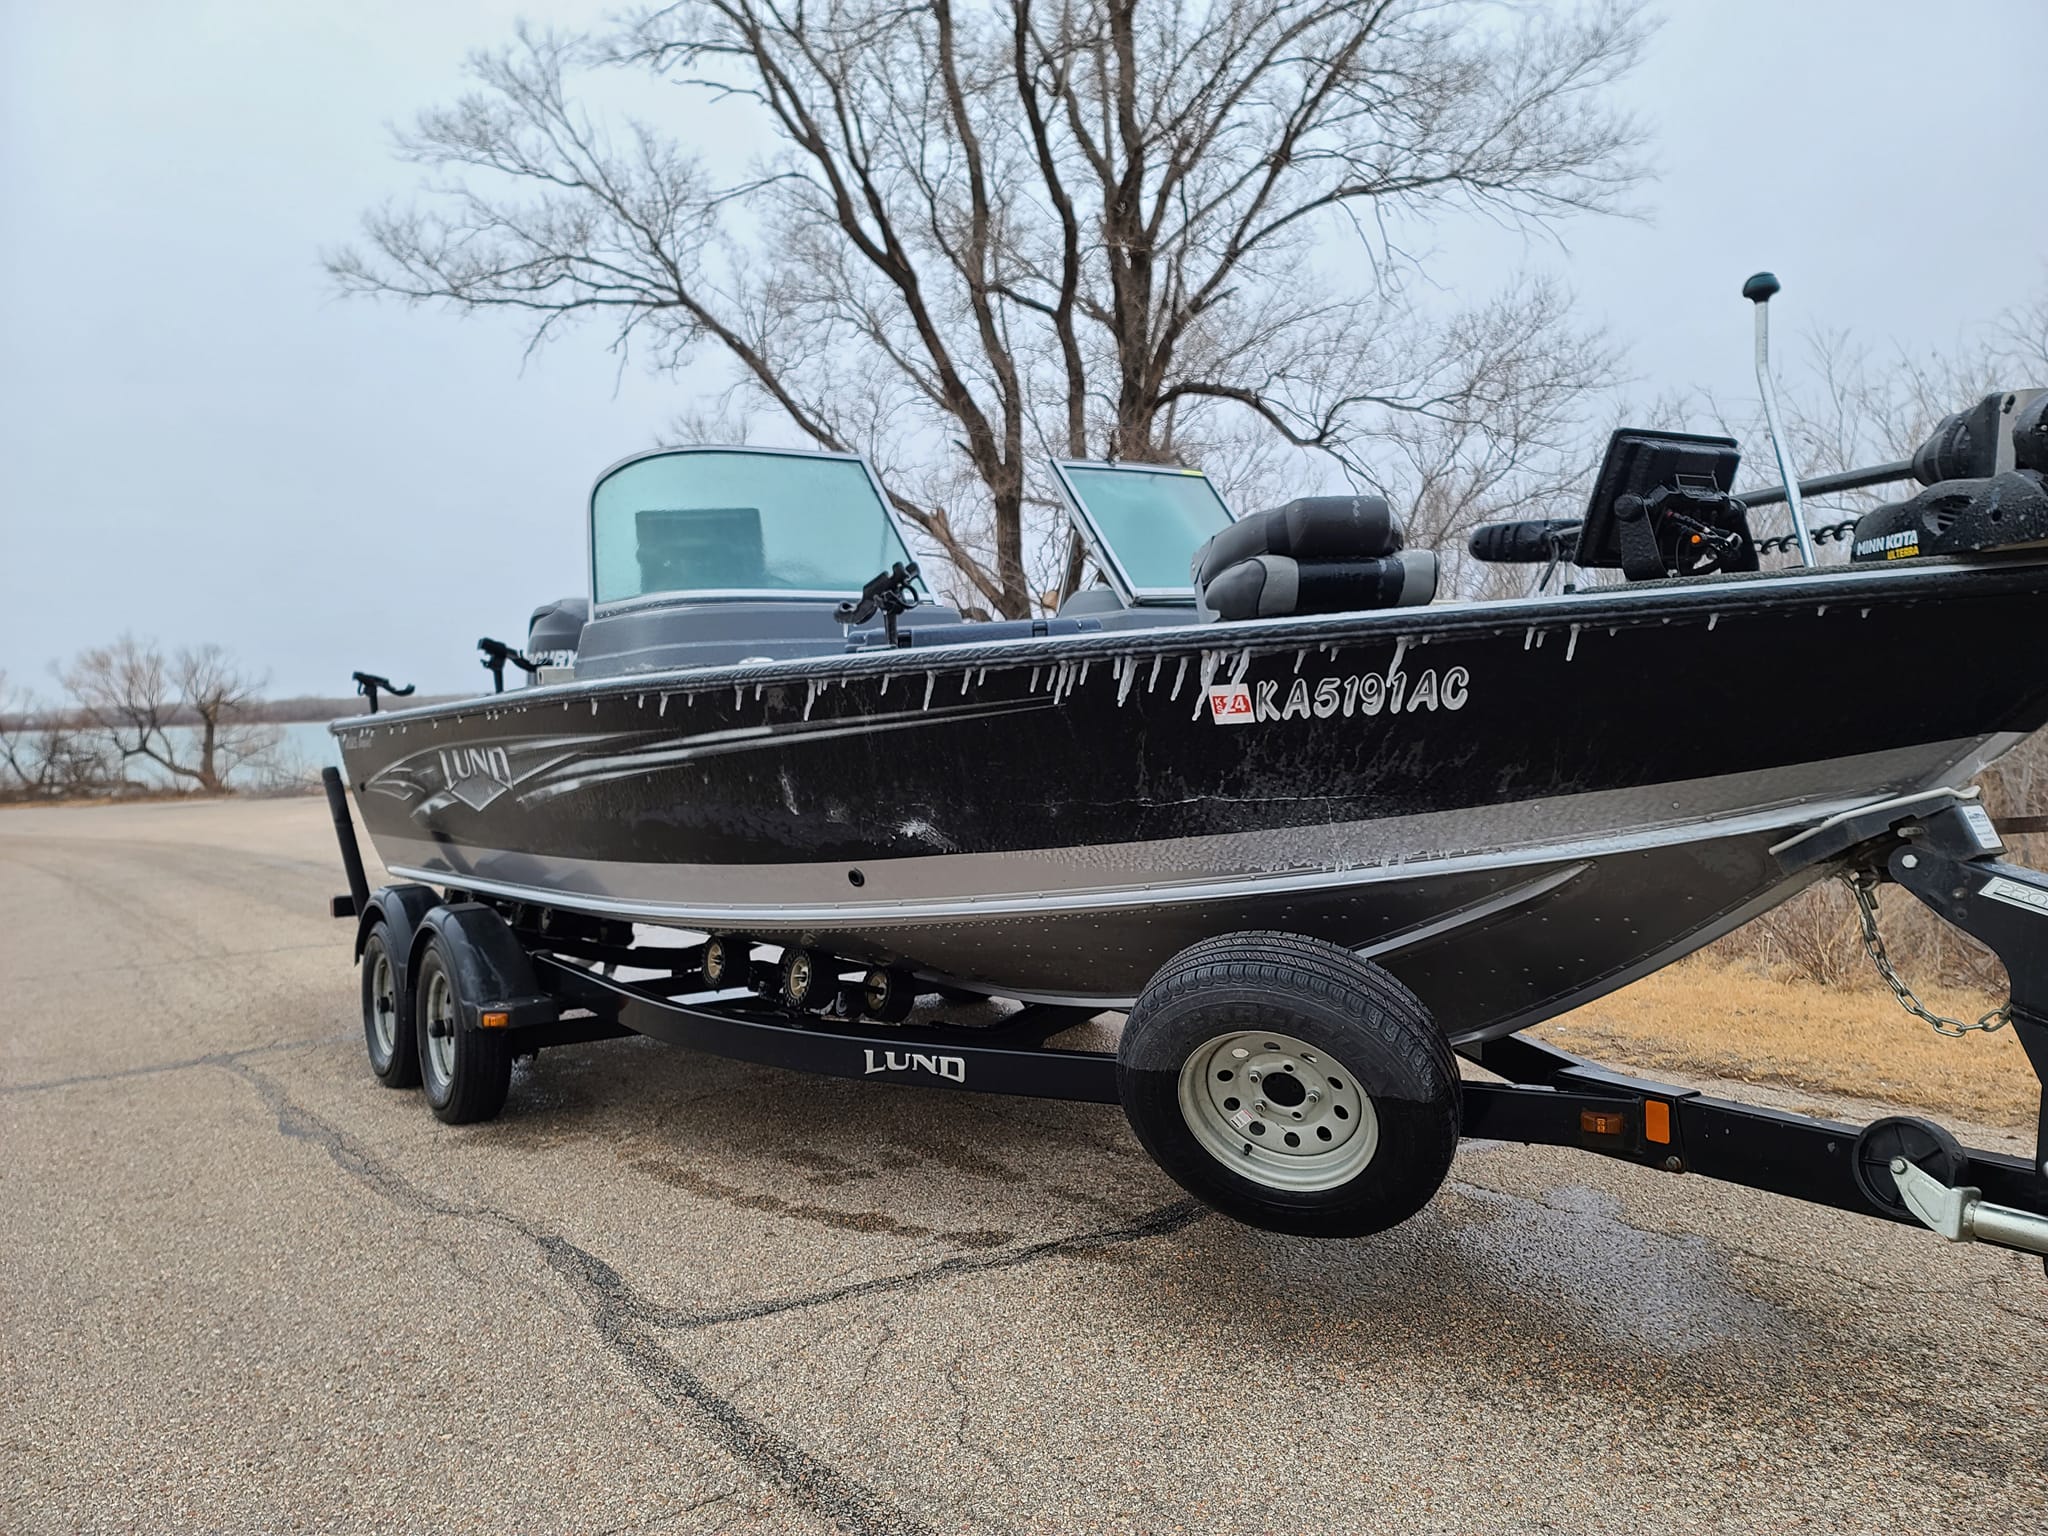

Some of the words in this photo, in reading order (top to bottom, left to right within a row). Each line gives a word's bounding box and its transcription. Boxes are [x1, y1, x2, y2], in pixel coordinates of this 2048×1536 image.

[1857, 537, 1885, 556] MINN
[1886, 530, 1919, 549] KOTA
[1256, 666, 1470, 722] KA5191AC
[438, 747, 514, 790] LUND
[864, 1049, 965, 1083] LUND
